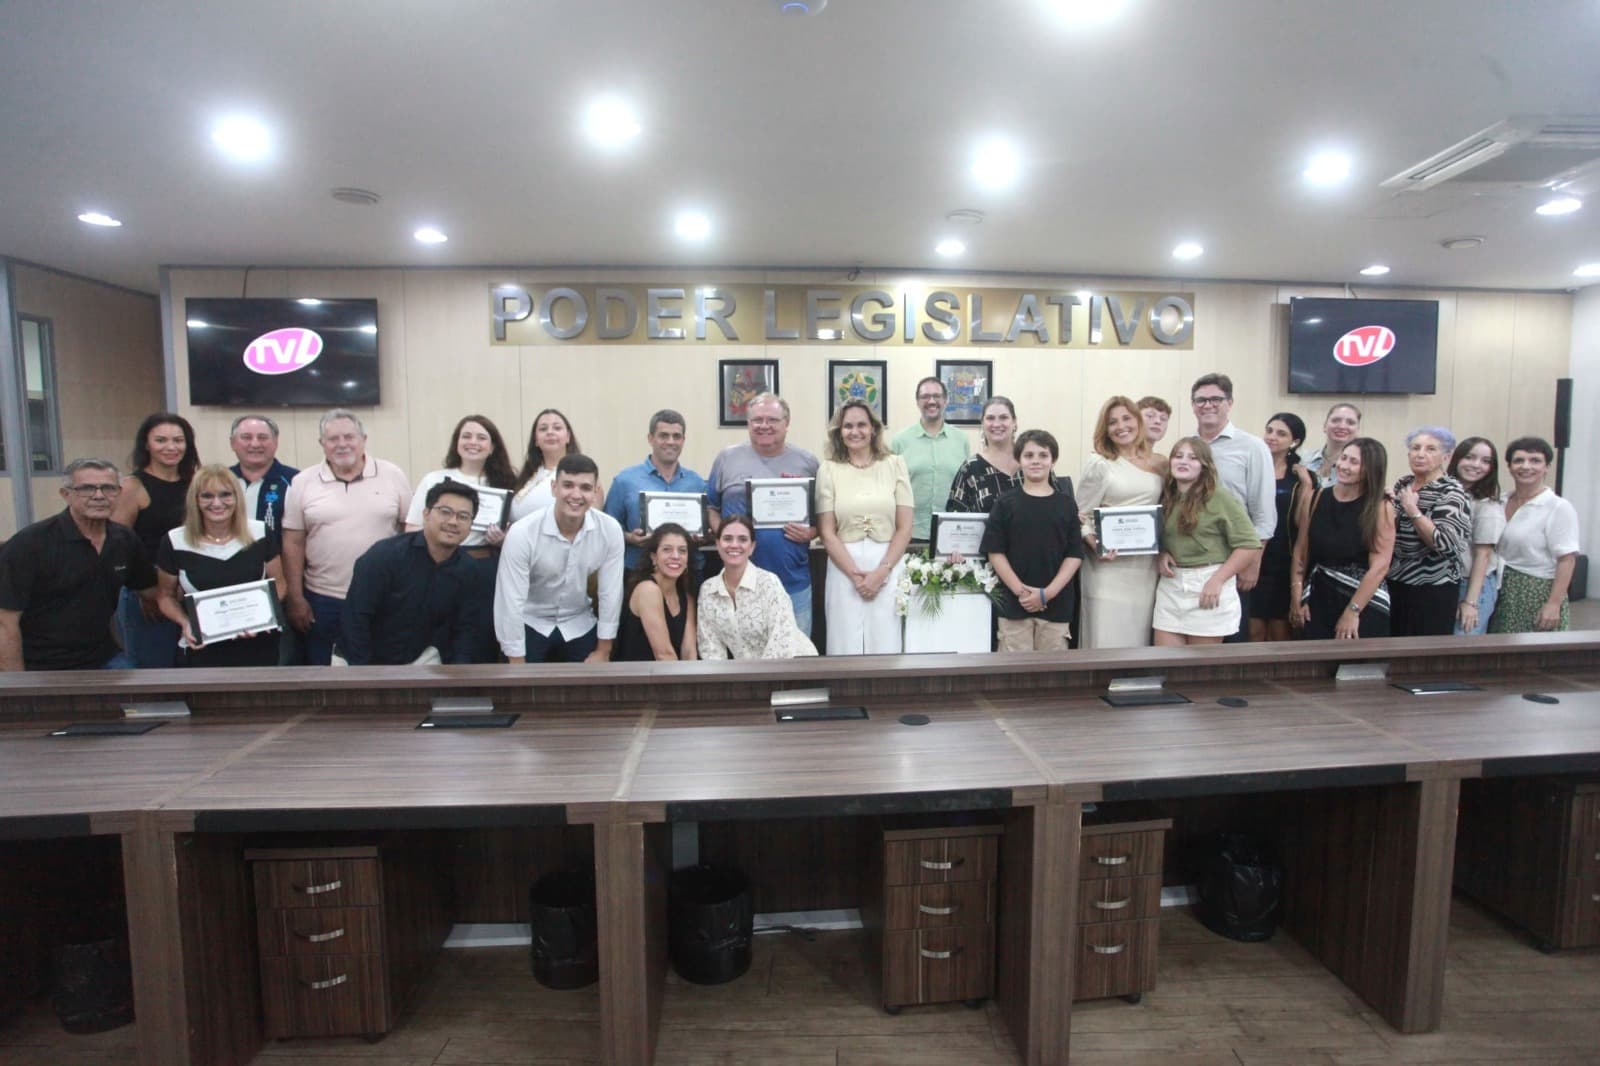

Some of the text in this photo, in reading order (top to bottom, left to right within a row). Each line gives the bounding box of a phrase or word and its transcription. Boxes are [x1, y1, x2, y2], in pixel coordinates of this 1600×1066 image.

[492, 286, 1195, 345] PODER LEGISLATIVO
[250, 330, 318, 365] TVL
[1338, 327, 1392, 358] TVL
